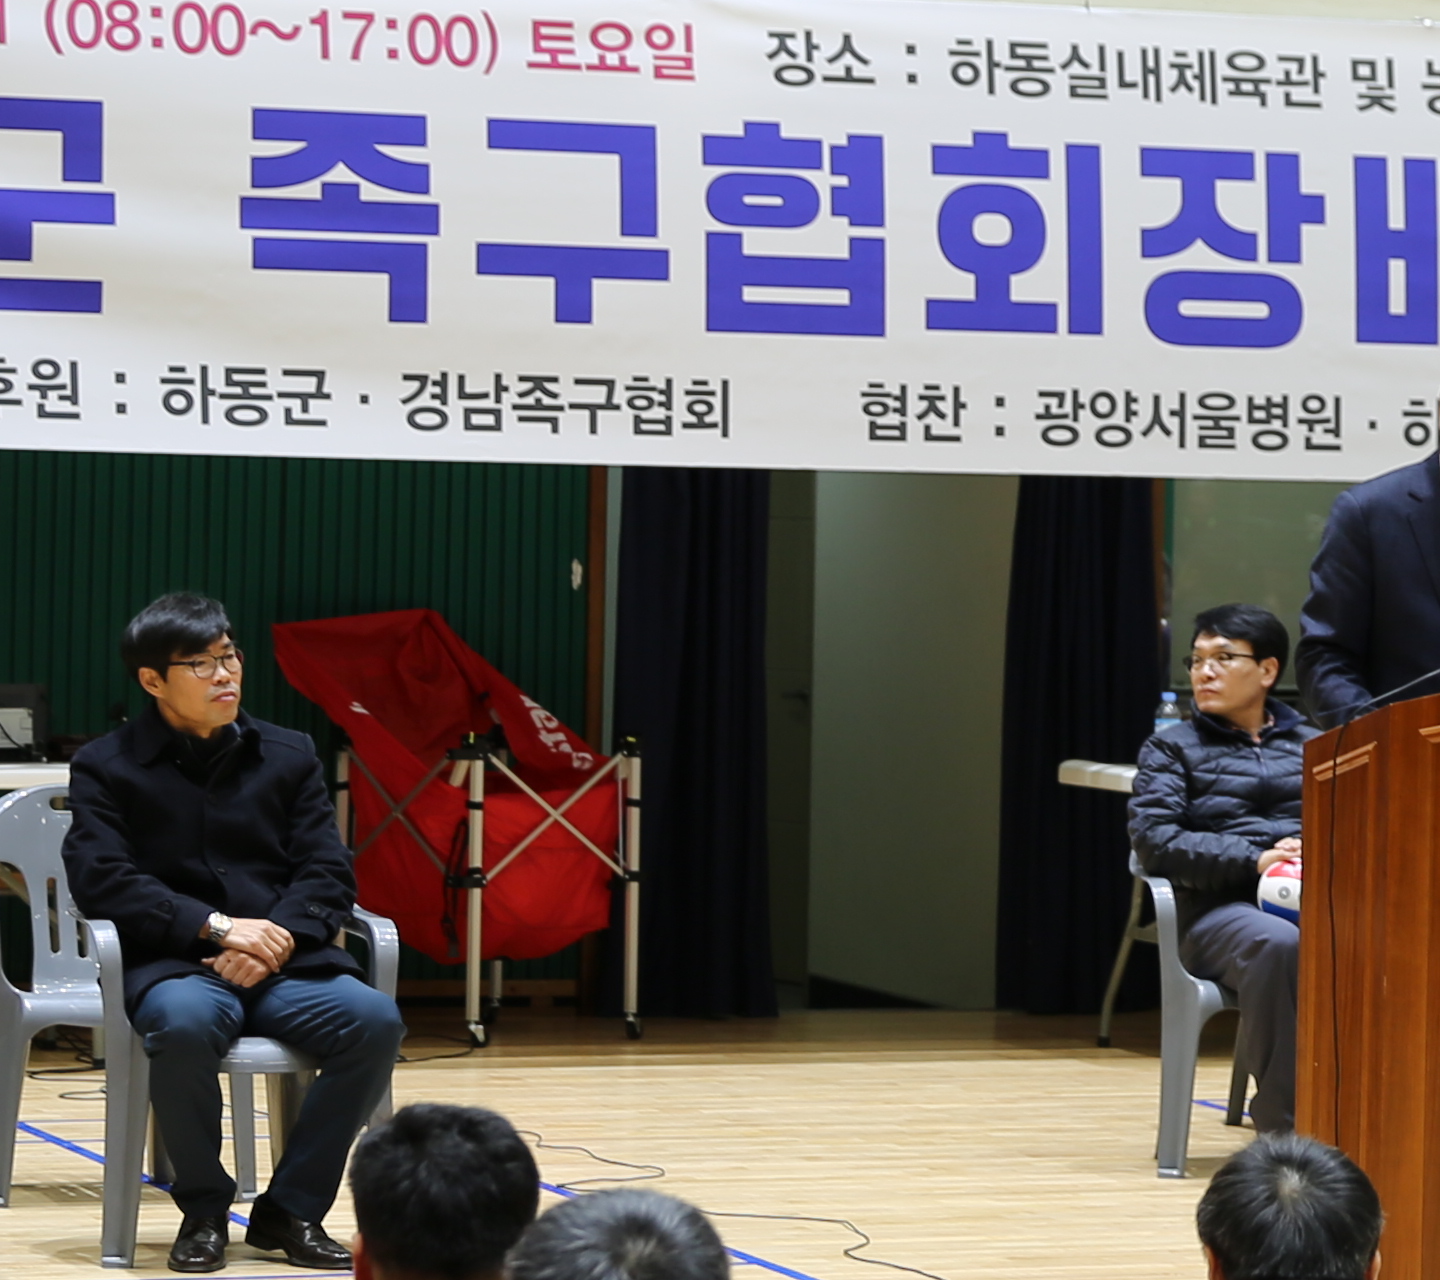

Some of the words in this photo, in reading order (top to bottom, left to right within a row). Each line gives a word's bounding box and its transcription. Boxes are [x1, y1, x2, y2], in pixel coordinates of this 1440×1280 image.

[526, 20, 695, 81] 토요일
[766, 30, 876, 87] 장소
[948, 38, 1326, 109] 하동실내체육관
[1351, 57, 1396, 112] 및
[159, 364, 333, 428] 하동군
[400, 370, 730, 439] 경남족구협회
[859, 382, 968, 443] 협찬
[1034, 388, 1343, 453] 광양서울병원
